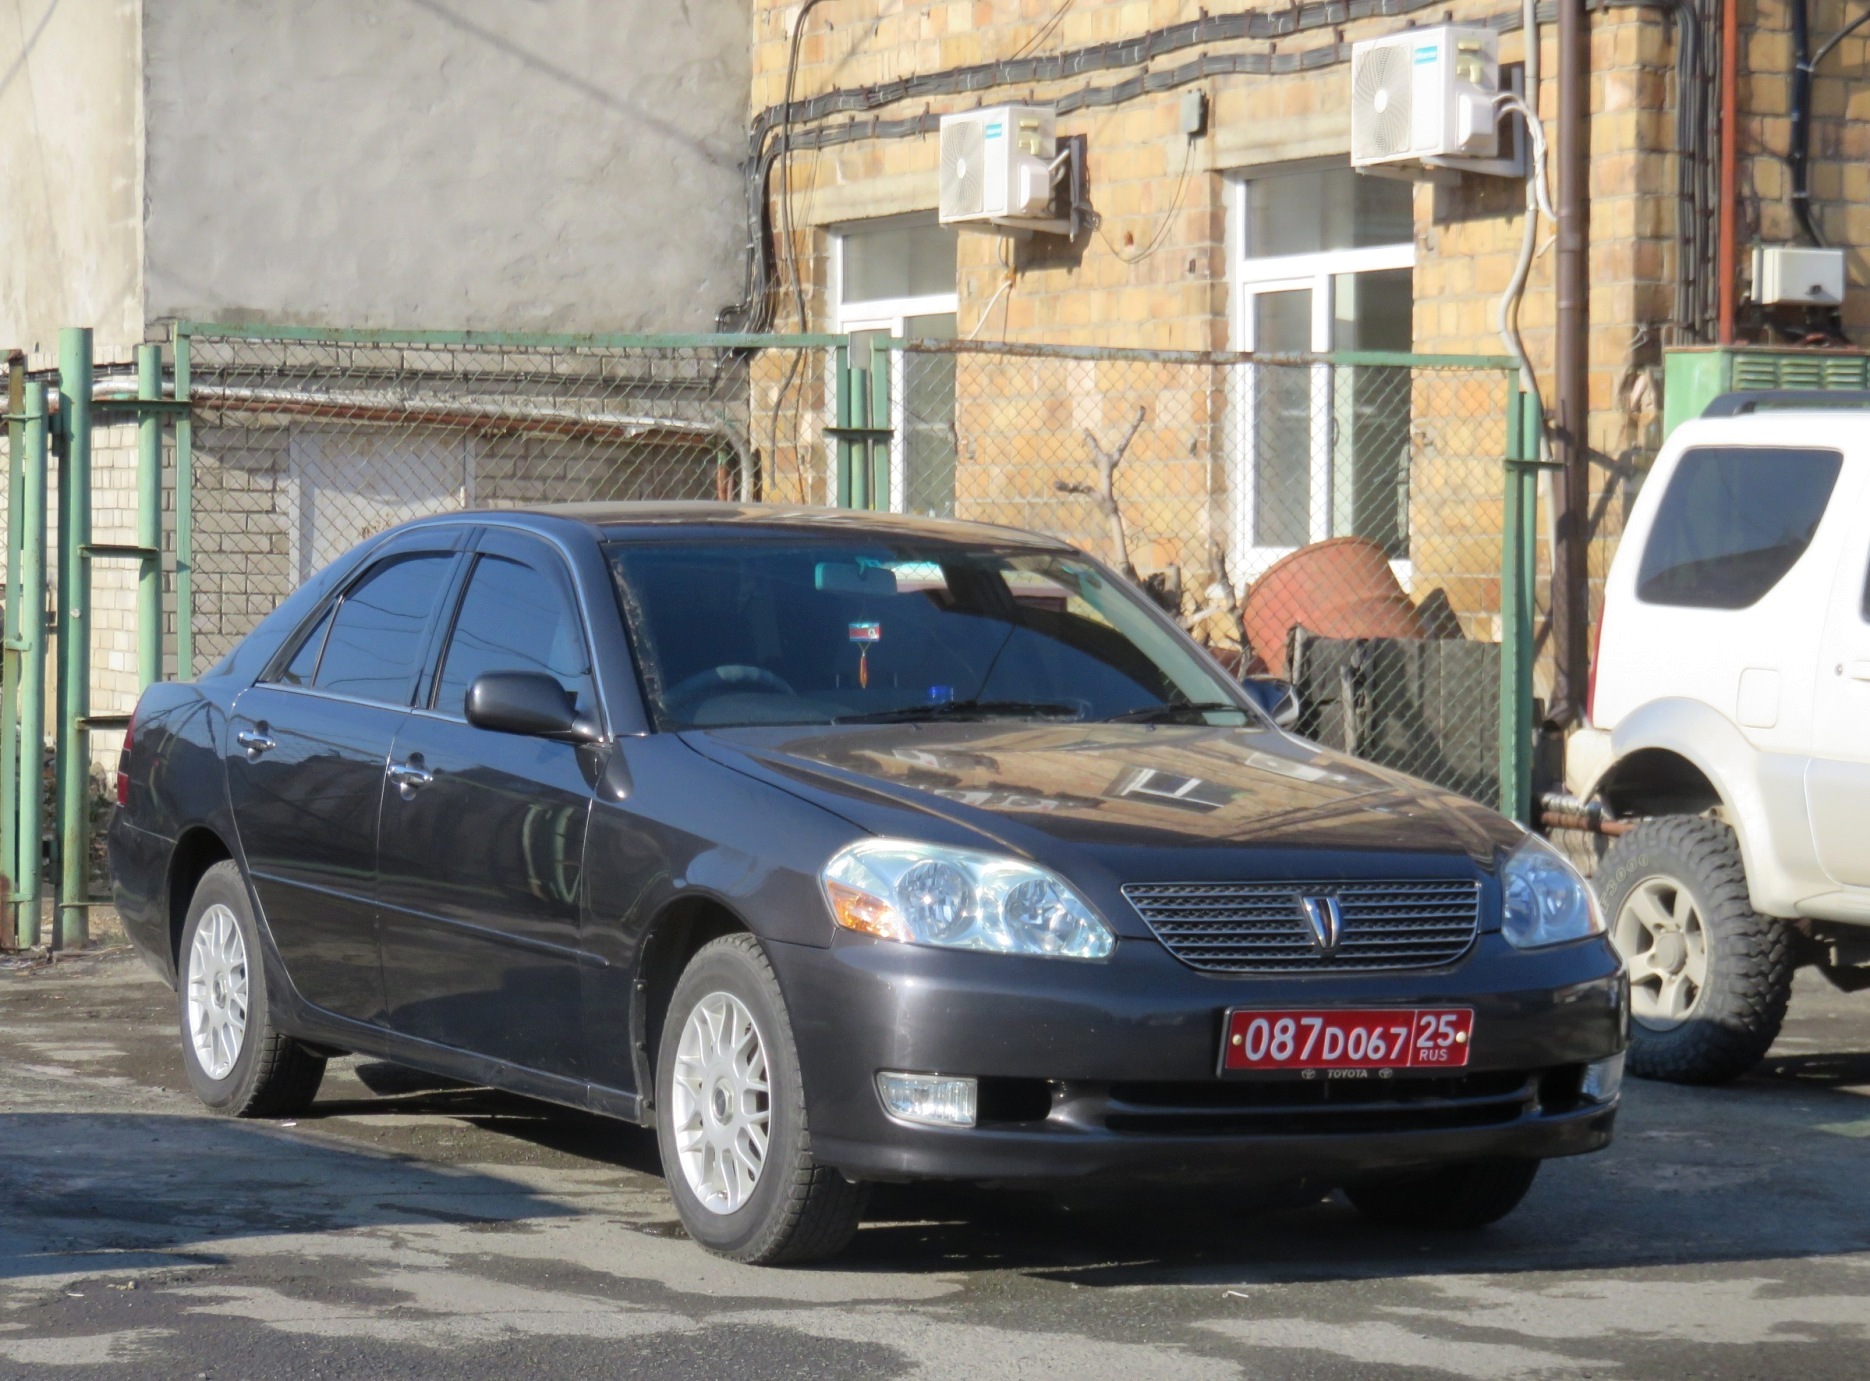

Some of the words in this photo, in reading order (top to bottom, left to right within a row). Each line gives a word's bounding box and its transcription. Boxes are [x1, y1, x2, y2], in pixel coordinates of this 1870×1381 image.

[1416, 1014, 1457, 1048] 25
[1419, 1049, 1448, 1062] RUS
[1327, 1069, 1368, 1079] TOYOTA
